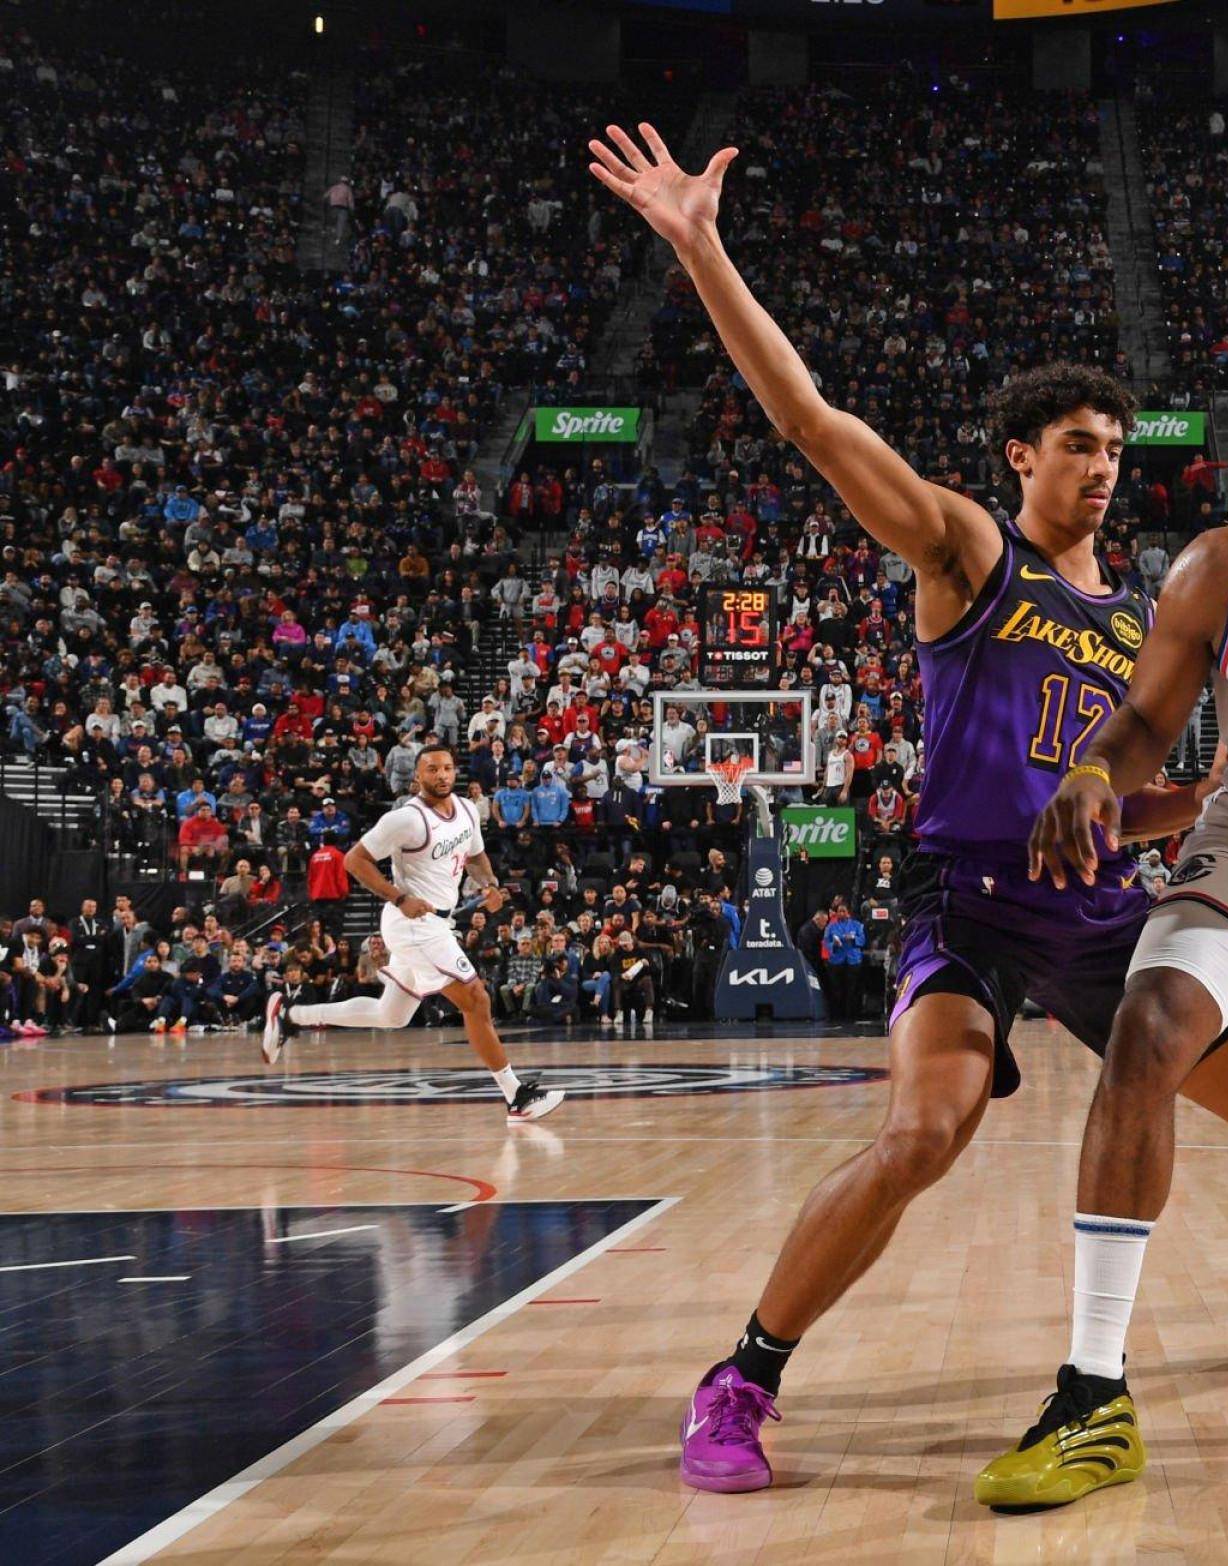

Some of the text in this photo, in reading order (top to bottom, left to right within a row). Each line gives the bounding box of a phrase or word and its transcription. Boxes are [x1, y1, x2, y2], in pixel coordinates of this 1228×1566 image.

[552, 411, 624, 438] Sprite
[1127, 414, 1189, 441] prite
[723, 593, 764, 611] 2:28
[727, 611, 761, 645] 15
[725, 651, 768, 661] TISSOT
[786, 816, 849, 843] prite
[752, 887, 777, 898] AT&T
